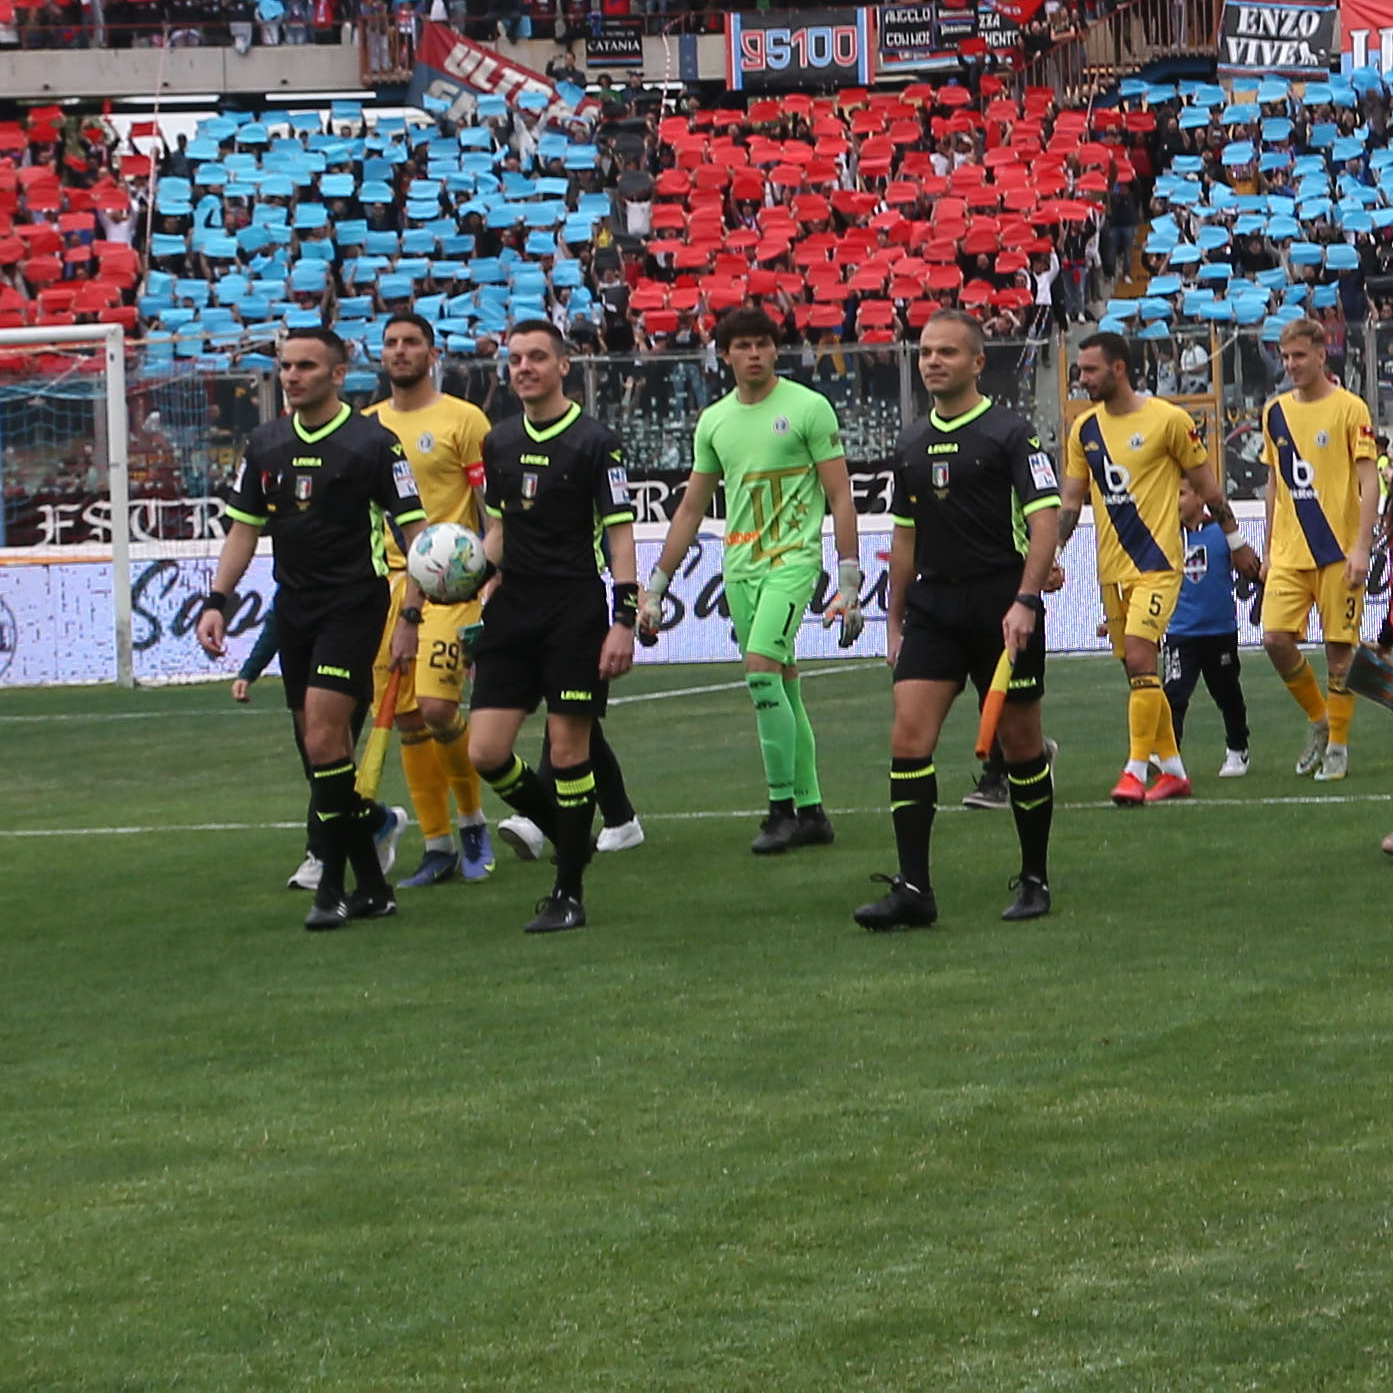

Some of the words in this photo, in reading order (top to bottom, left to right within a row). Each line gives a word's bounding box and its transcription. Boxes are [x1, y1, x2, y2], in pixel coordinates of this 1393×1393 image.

[1236, 7, 1320, 38] ENZO
[587, 39, 641, 53] CATANIA
[1226, 36, 1301, 67] VIVE
[782, 602, 795, 636] 1
[1149, 593, 1162, 617] 5
[1345, 596, 1356, 619] 3
[430, 639, 460, 671] 29
